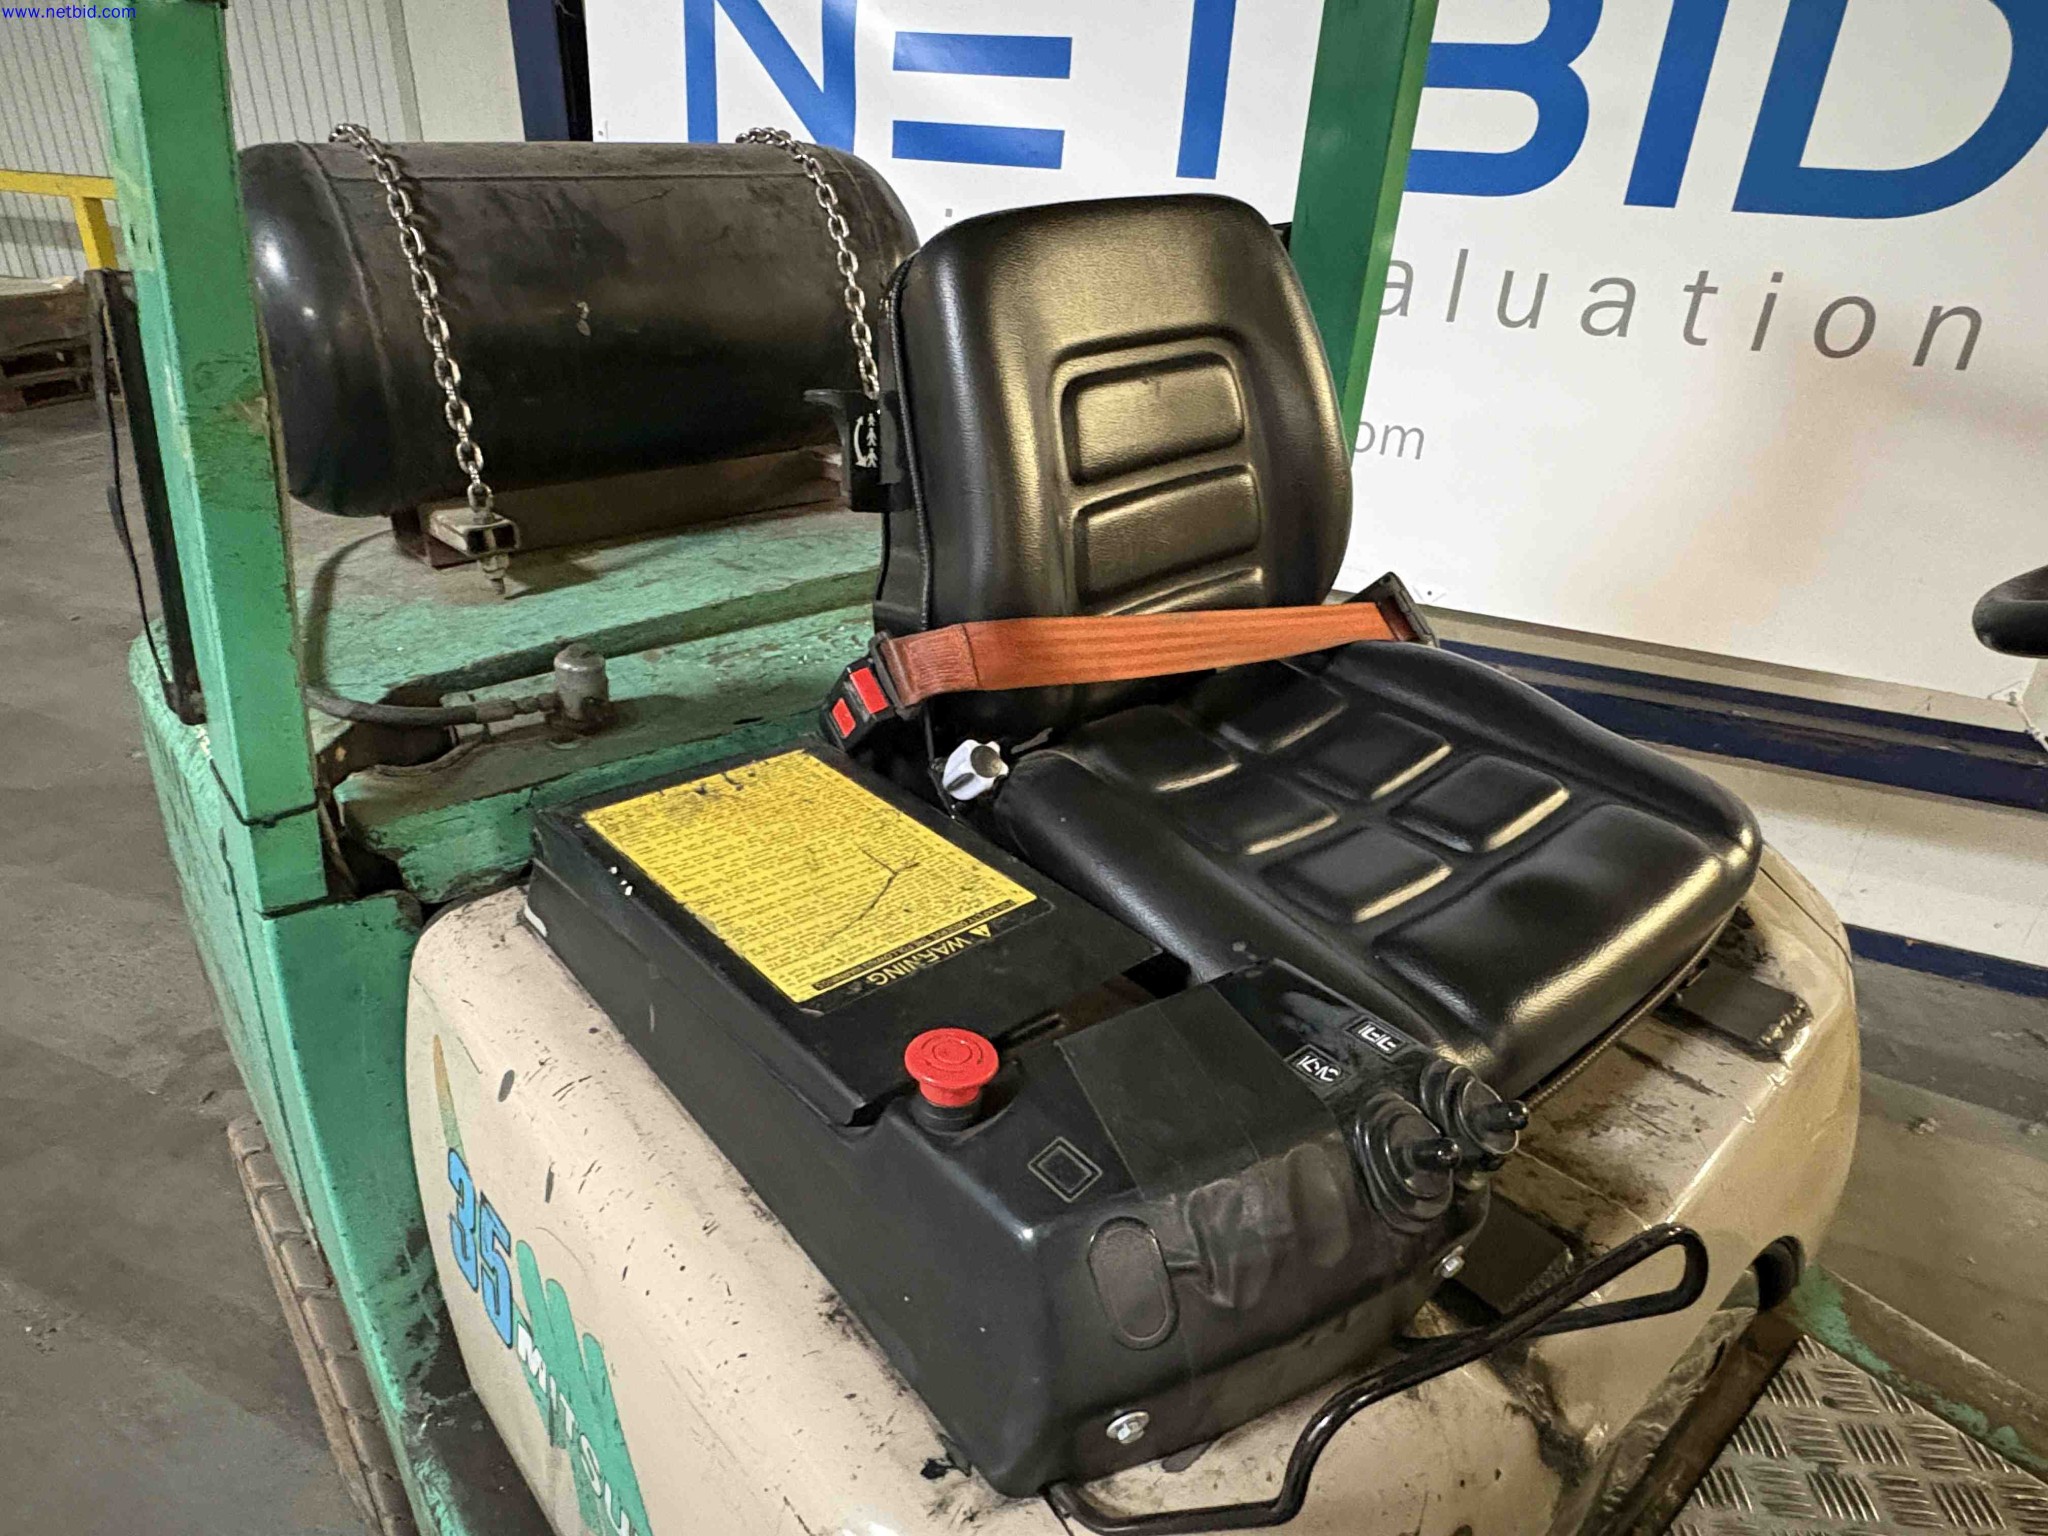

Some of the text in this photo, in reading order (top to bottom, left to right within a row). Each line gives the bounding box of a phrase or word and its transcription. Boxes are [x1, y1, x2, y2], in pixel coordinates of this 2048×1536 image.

[1380, 249, 1983, 371] aluation
[1355, 421, 1425, 460] om
[867, 937, 973, 986] WARNING
[447, 1147, 513, 1349] 35
[516, 1320, 638, 1536] MITSU
